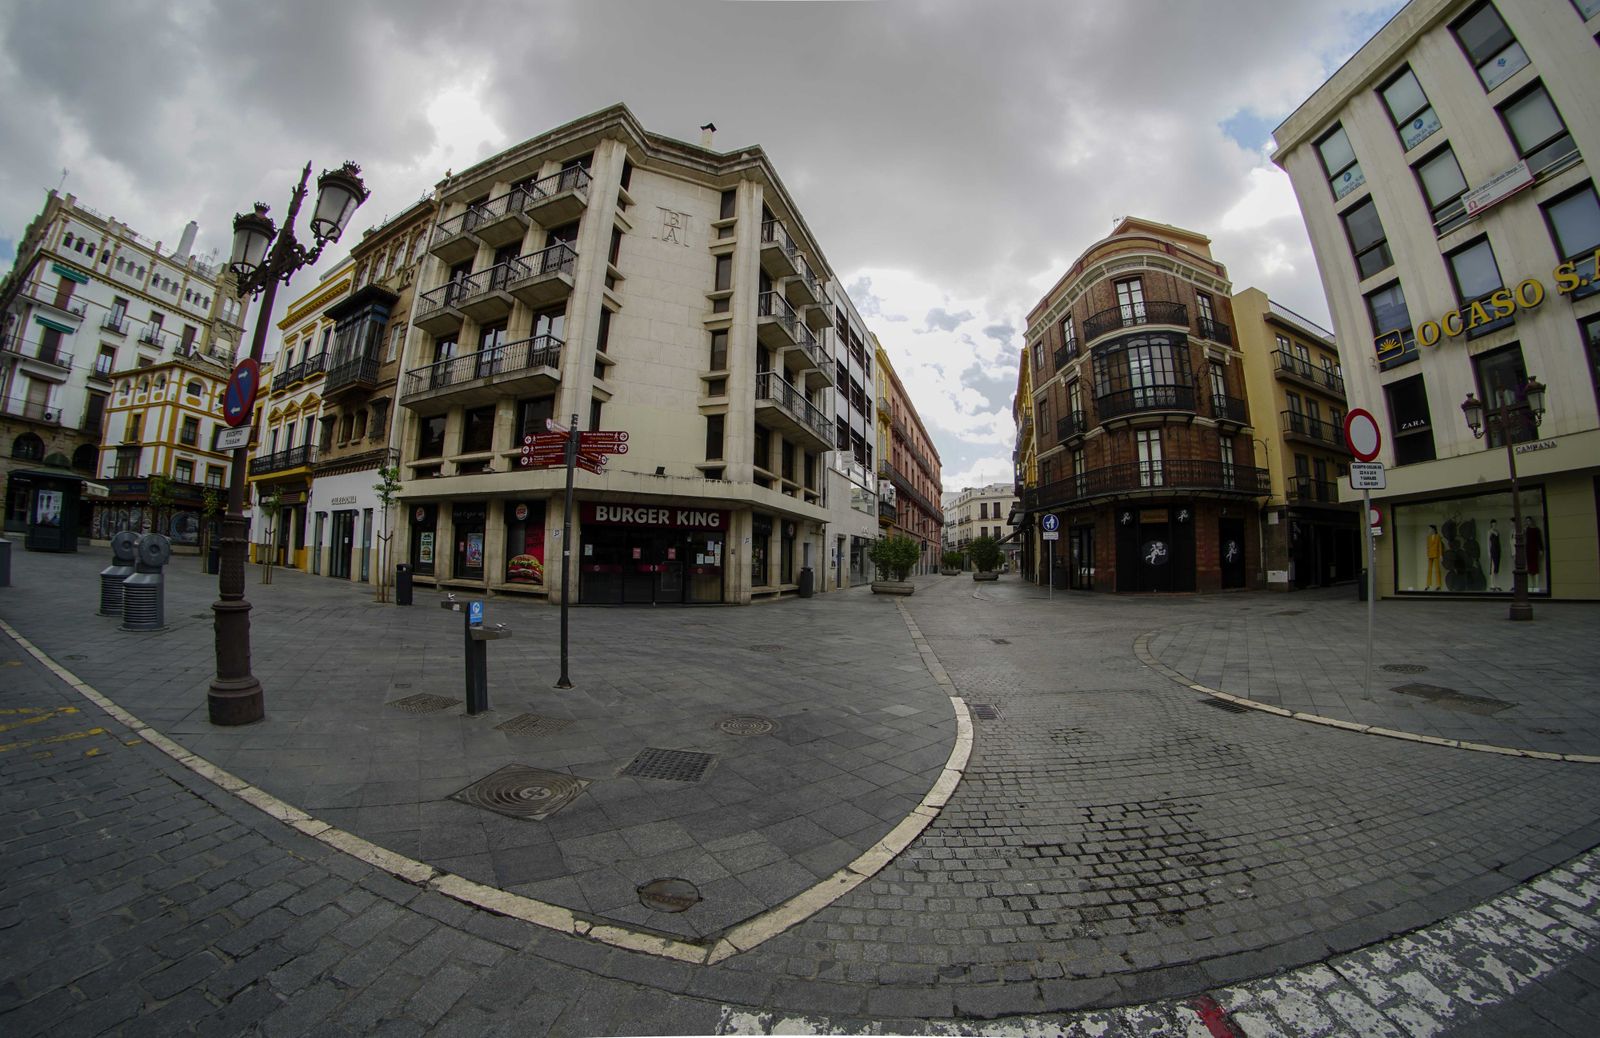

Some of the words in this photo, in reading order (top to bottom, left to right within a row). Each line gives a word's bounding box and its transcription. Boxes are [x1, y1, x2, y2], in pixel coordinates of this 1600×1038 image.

[1417, 278, 1545, 347] OCASO
[1401, 419, 1425, 430] ZARA
[1516, 440, 1557, 455] CAMPANA
[595, 505, 670, 525] BURGER
[676, 511, 720, 527] KING
